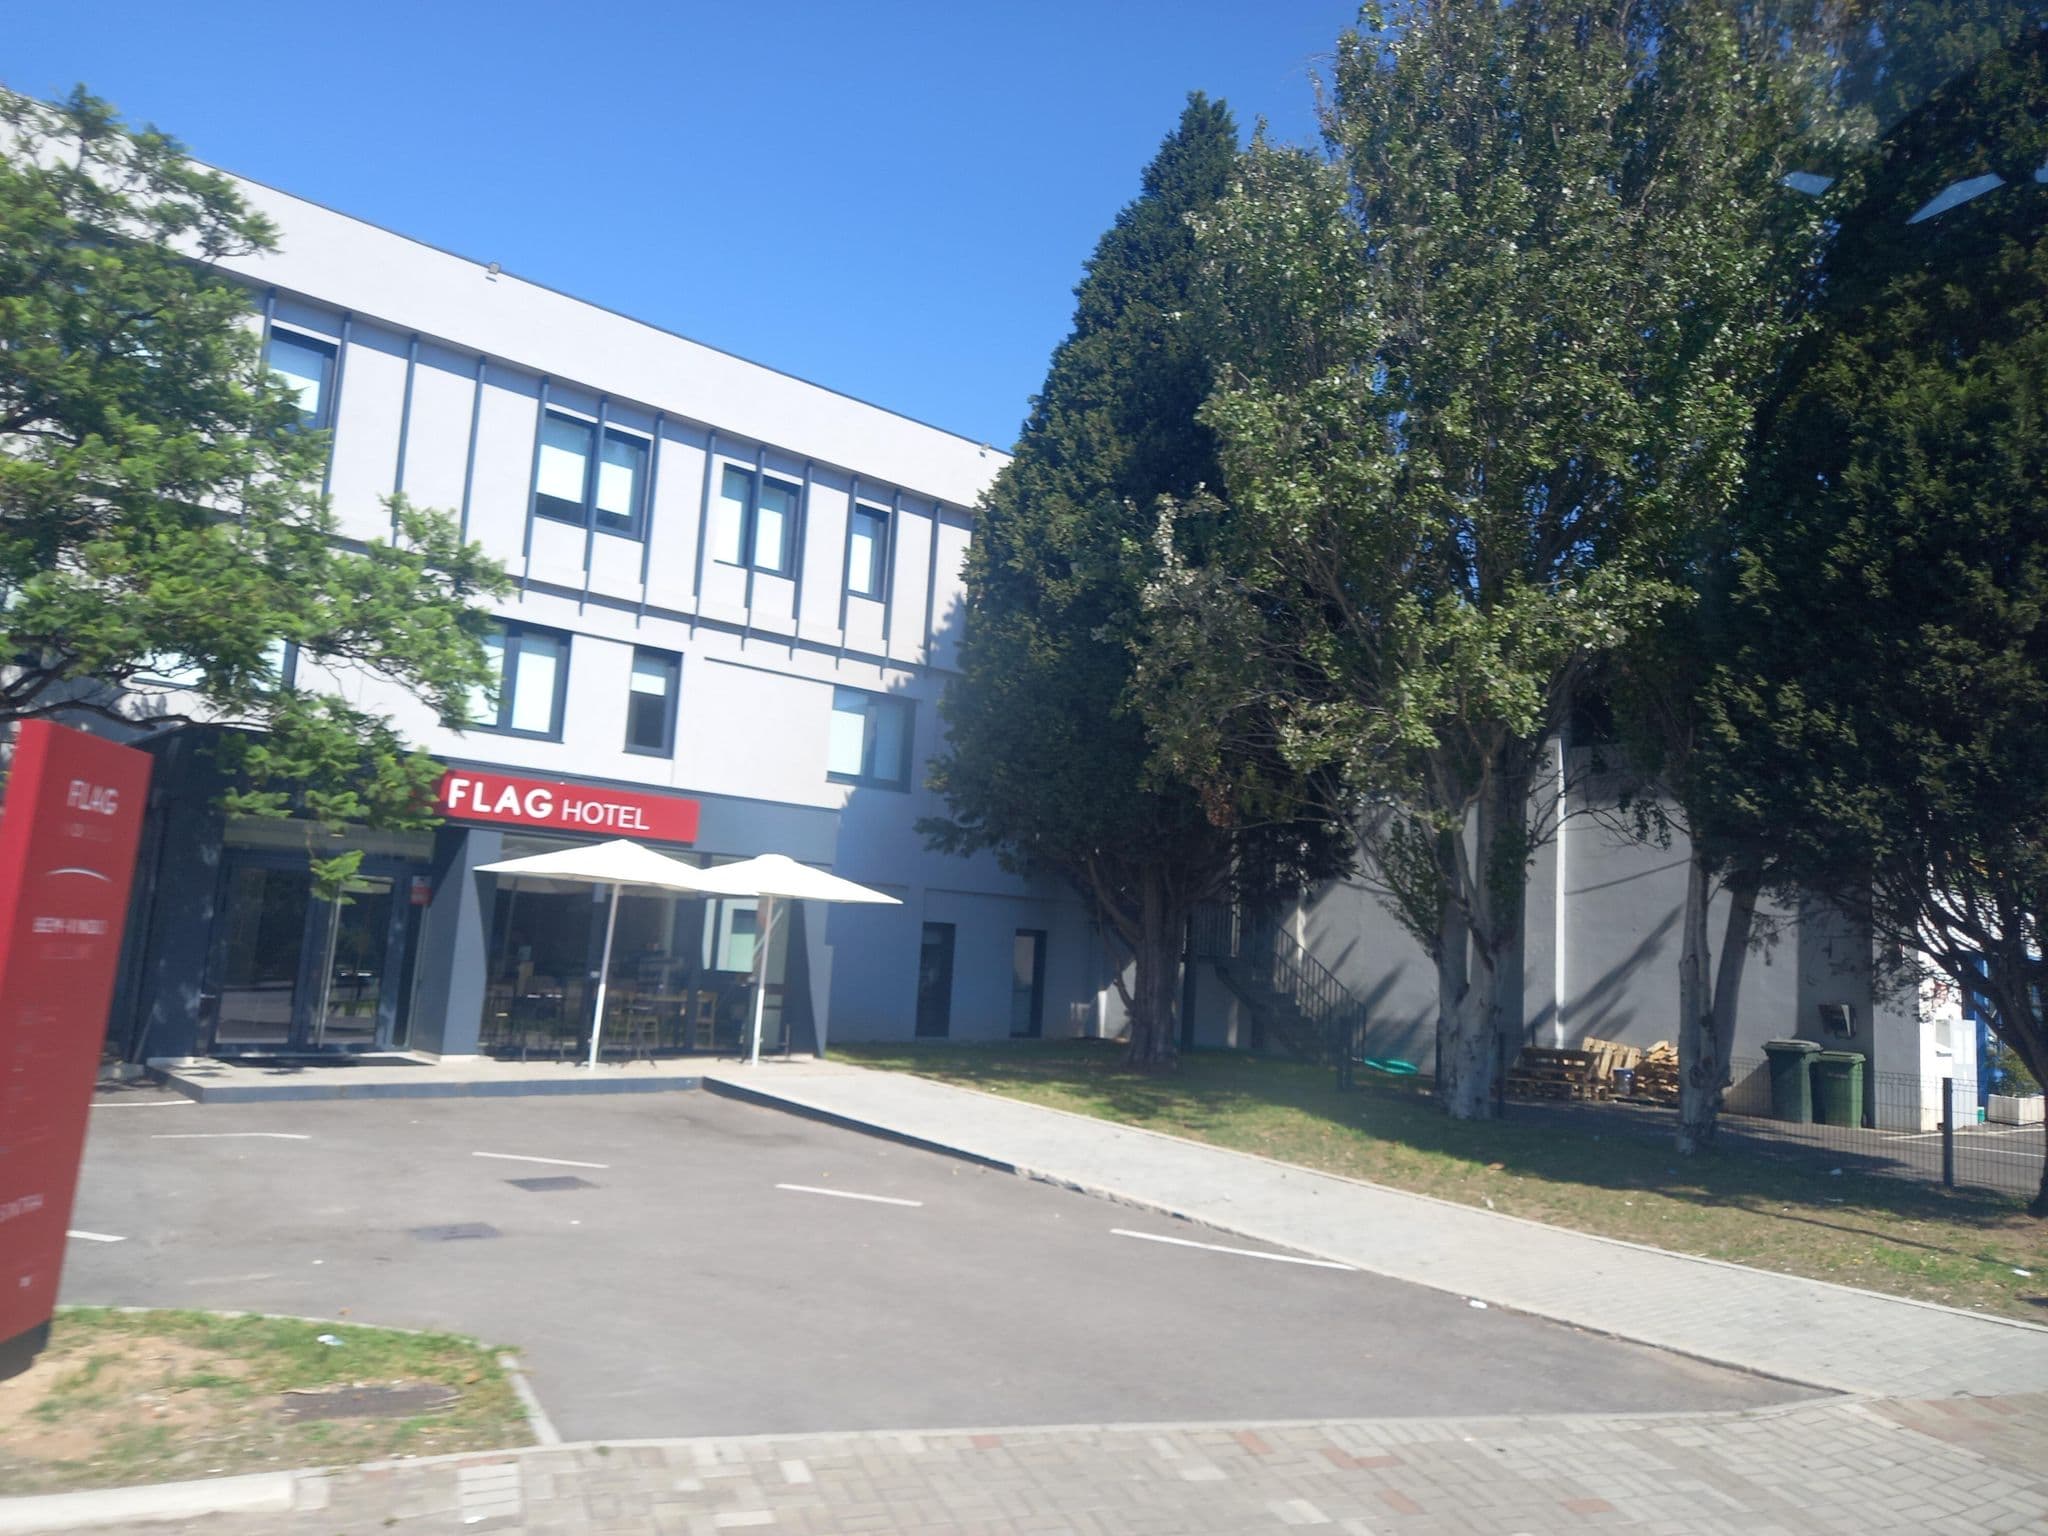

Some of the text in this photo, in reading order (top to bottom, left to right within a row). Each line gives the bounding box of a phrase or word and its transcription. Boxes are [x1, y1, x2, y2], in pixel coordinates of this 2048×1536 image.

[67, 780, 119, 815] FLAG
[448, 778, 650, 831] FLAG HOTEL
